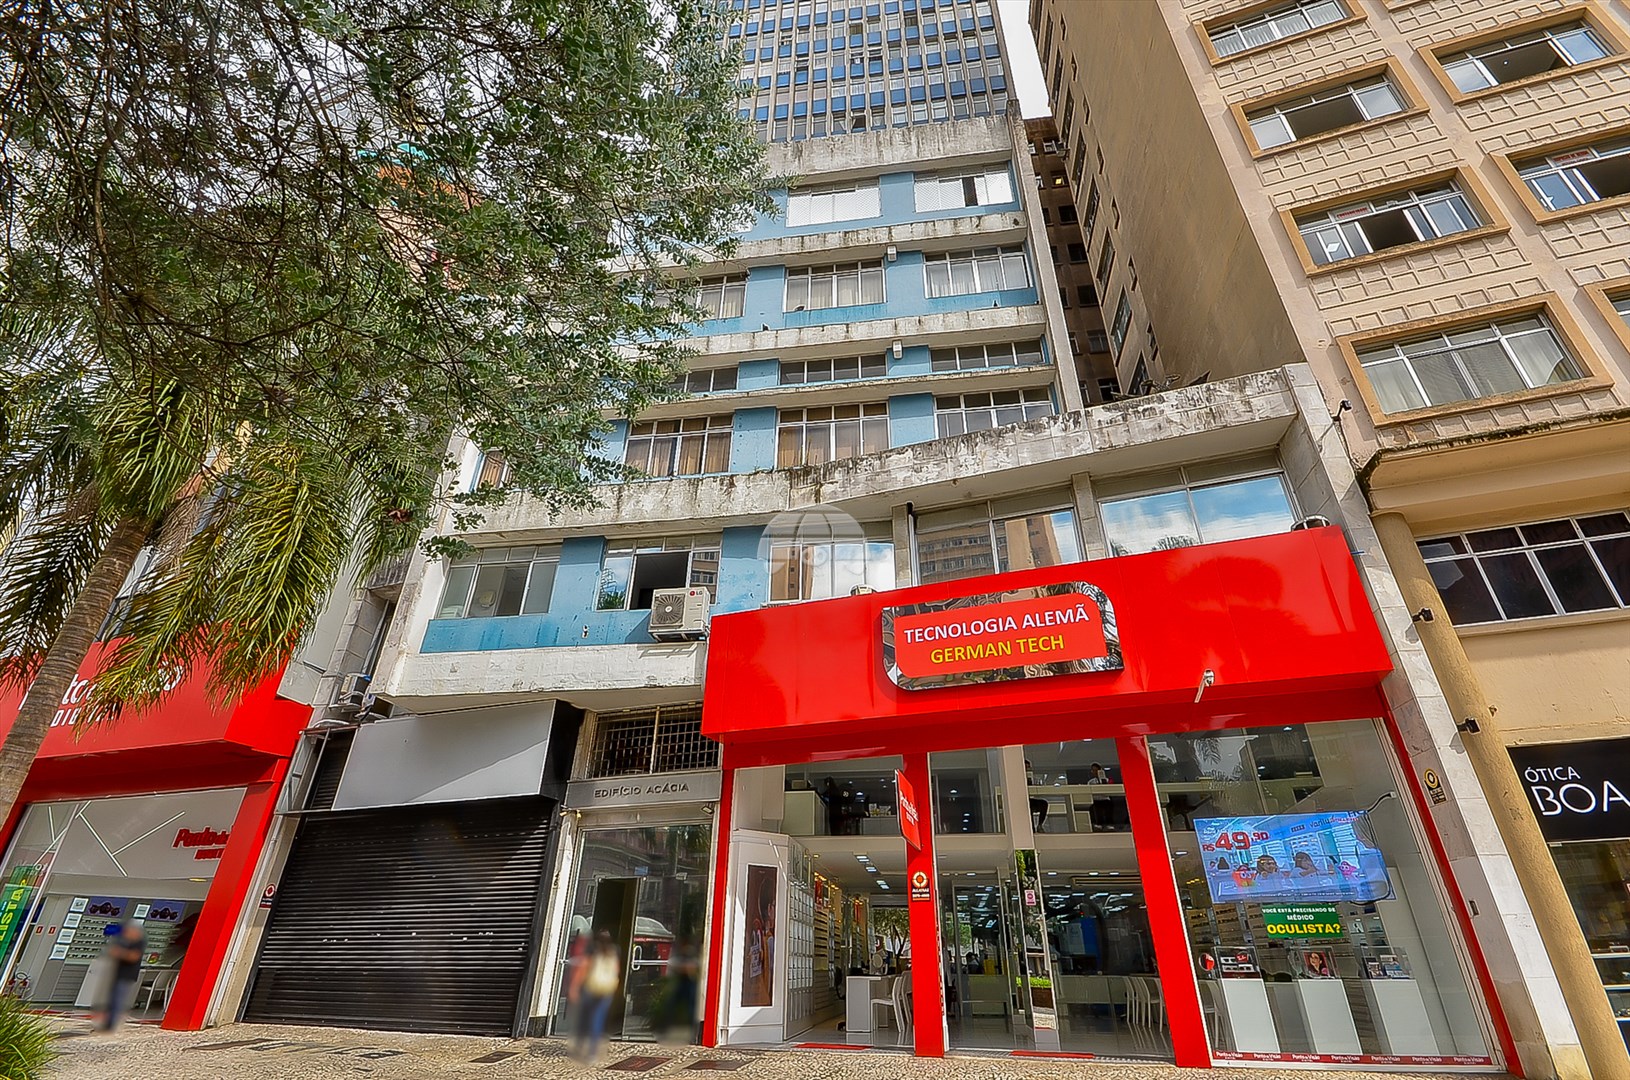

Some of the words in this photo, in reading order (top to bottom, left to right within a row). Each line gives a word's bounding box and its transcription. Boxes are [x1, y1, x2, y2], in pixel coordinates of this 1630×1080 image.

[903, 616, 1018, 644] TECNOLOGIA
[1021, 603, 1090, 629] ALEMÃ
[930, 640, 1012, 664] GERMAN
[1016, 634, 1066, 654] TECH
[1524, 766, 1581, 783] ÓTICA
[594, 785, 642, 799] EDIFÍCIO
[646, 782, 690, 795] ACÁCIA
[1530, 780, 1630, 816] BOA
[1266, 923, 1341, 934] OCULISTA?
